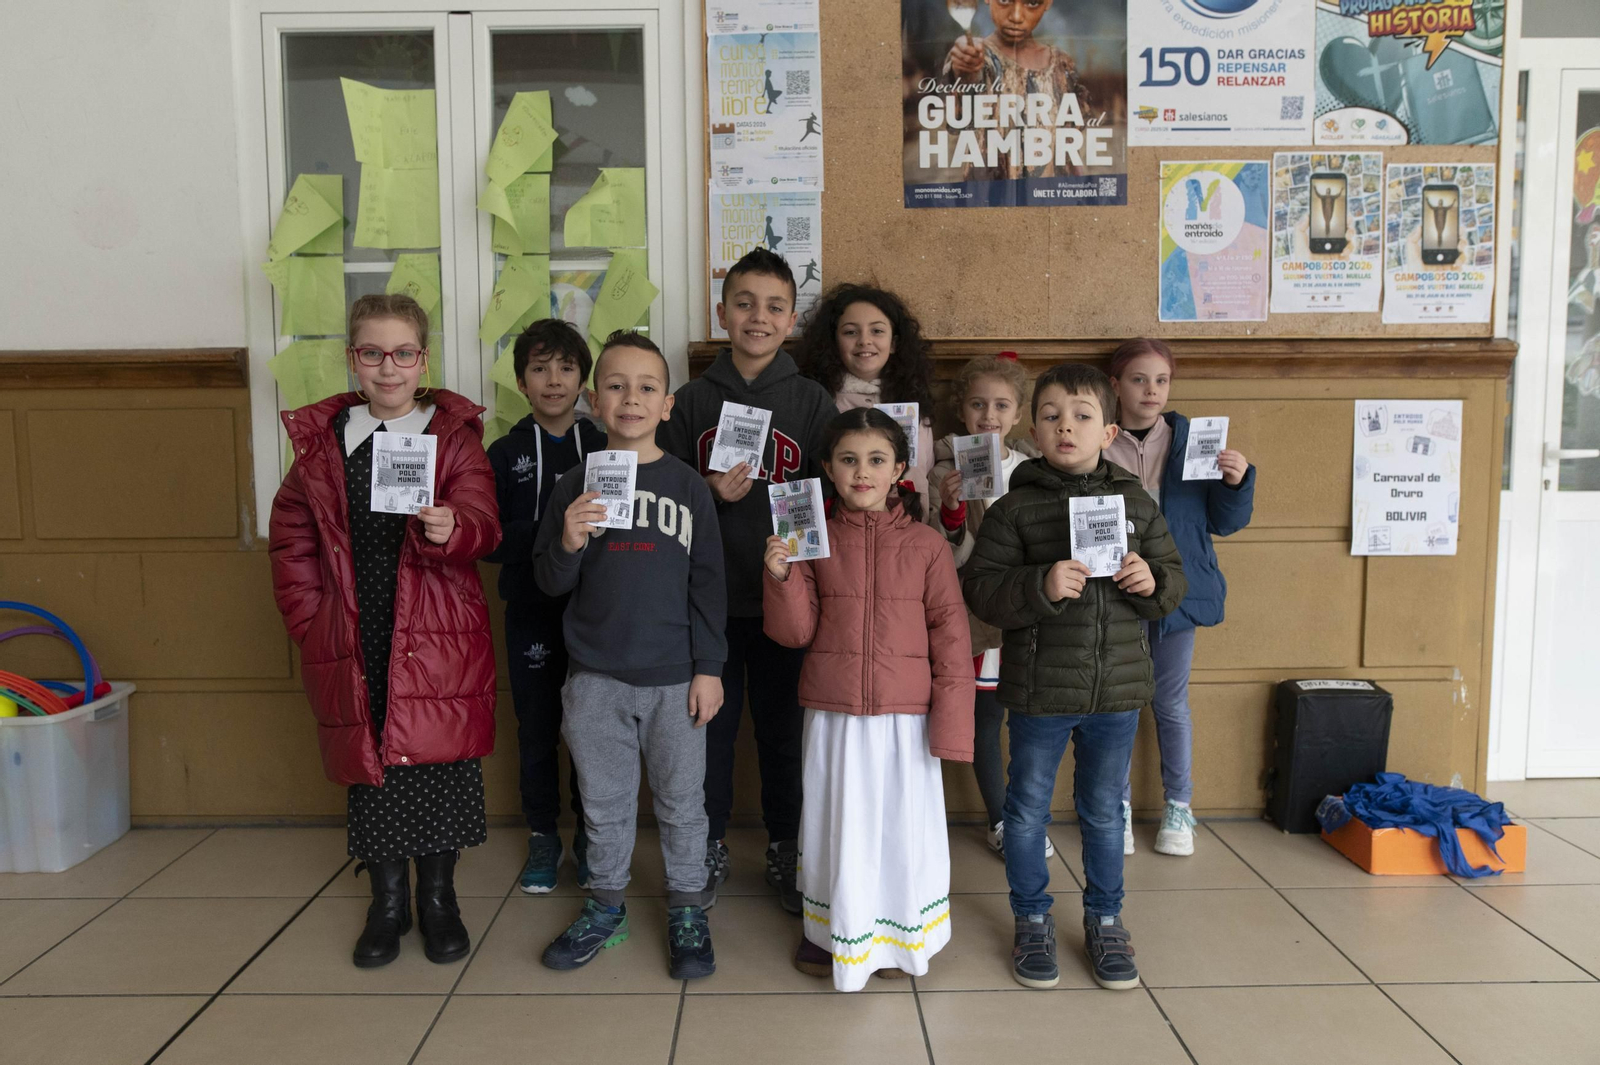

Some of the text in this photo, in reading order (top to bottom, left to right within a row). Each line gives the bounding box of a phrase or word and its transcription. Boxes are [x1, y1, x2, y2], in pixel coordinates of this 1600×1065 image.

[1174, 12, 1234, 39] expedición
[1369, 7, 1473, 34] HISTORIA
[719, 44, 765, 61] curso
[720, 61, 766, 78] monitor
[1139, 46, 1305, 87] 150 DAR GRACIAS
[1217, 63, 1286, 73] REPENSAR
[917, 76, 1006, 93] Declara la
[1217, 77, 1285, 86] RELANZAR
[719, 79, 764, 95] tempo
[721, 96, 767, 116] libre
[918, 93, 1084, 129] GUERRA
[1086, 112, 1106, 127] al
[1179, 112, 1228, 121] salesianos
[919, 128, 1113, 168] HAMBRE
[1033, 188, 1055, 198] ÚNETE
[721, 207, 767, 223] monitor
[721, 224, 764, 240] tempo
[1185, 229, 1223, 237] entroido
[1282, 261, 1372, 270] CAMPOBOSCO 2026
[1394, 272, 1485, 281] CAMPOBOSCO 2026
[734, 427, 760, 436] ENTROIDO
[1373, 473, 1440, 483] Carnaval de
[1391, 488, 1423, 498] Oruro
[1386, 511, 1427, 521] BOLIVIA
[1088, 521, 1118, 529] ENTROIDO
[608, 542, 630, 552] EAST
